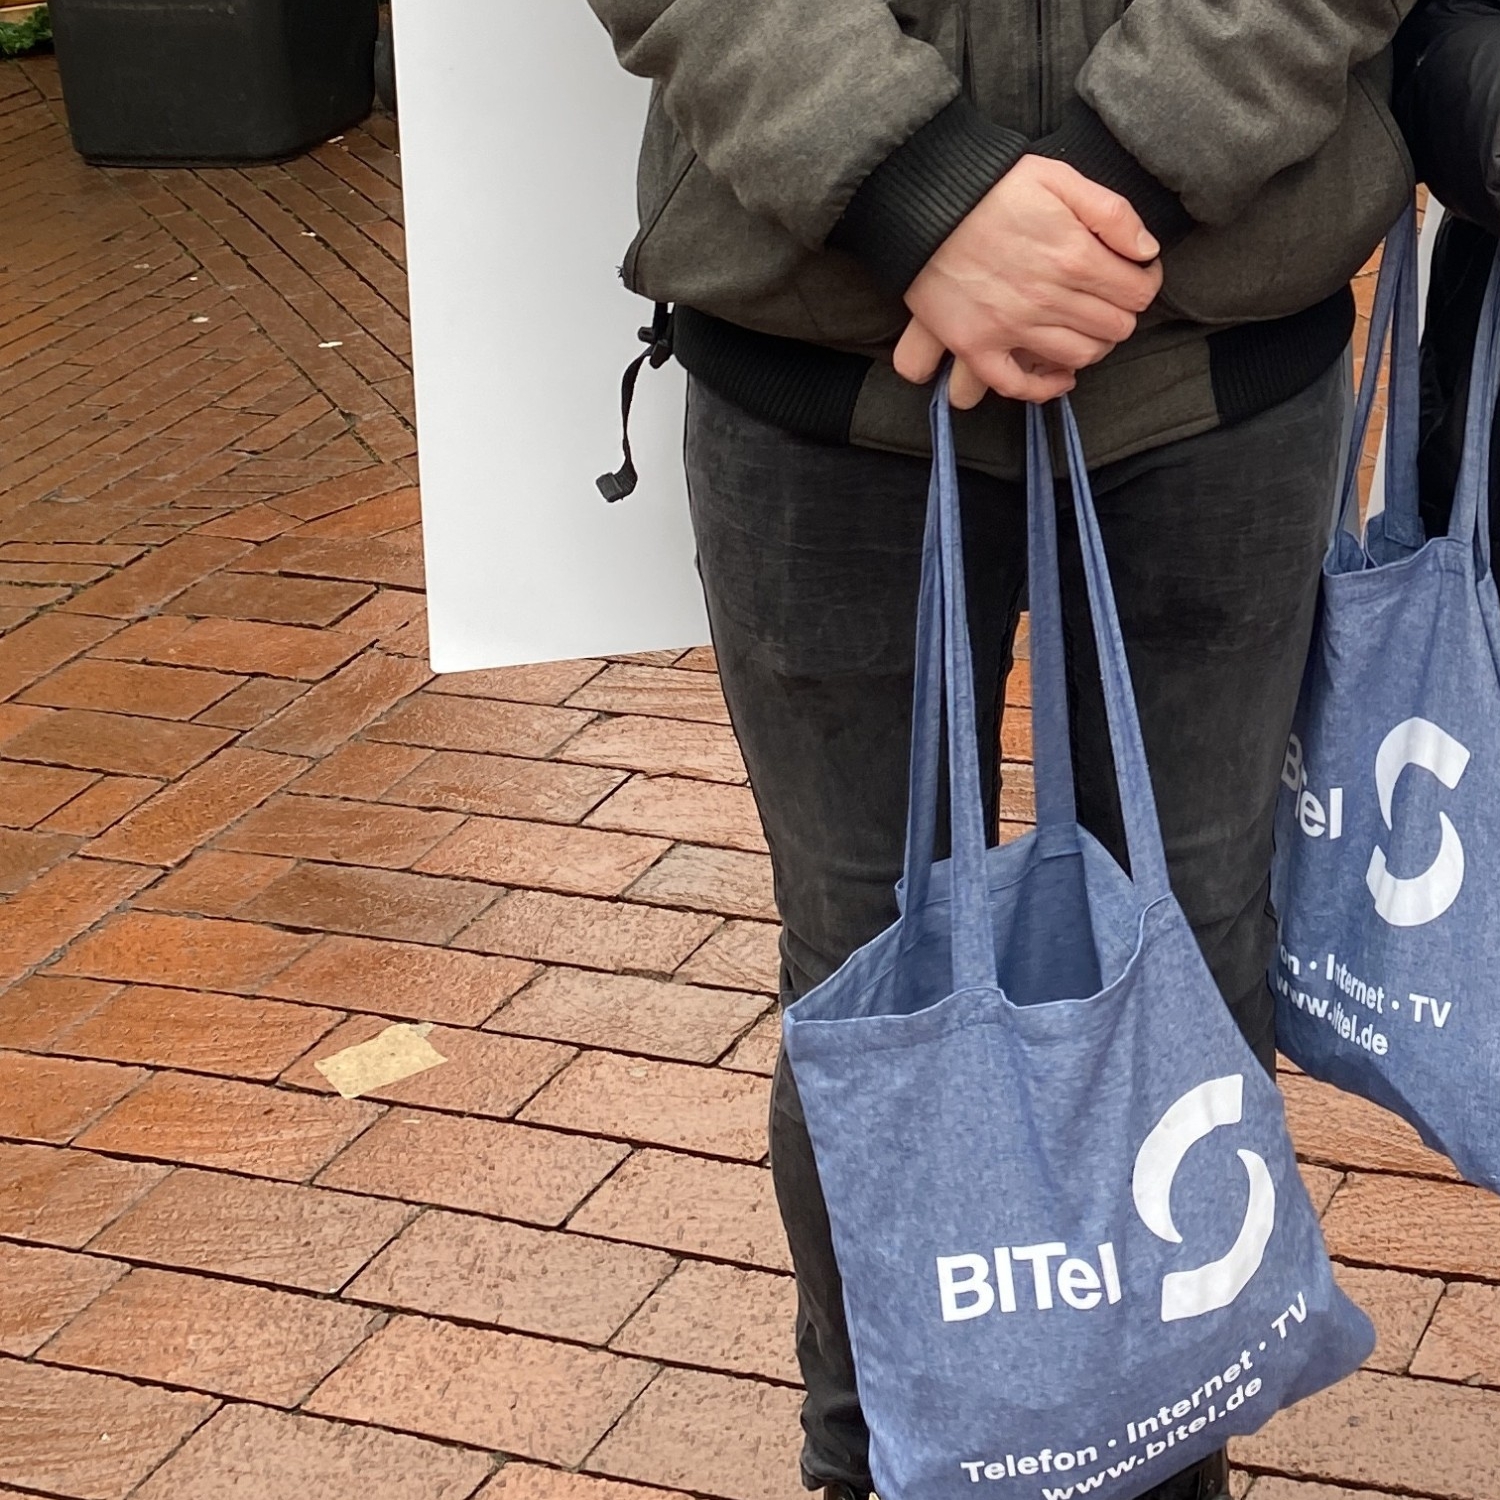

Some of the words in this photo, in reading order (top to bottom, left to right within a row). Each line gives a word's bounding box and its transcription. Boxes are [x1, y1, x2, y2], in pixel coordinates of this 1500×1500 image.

[1326, 954, 1385, 1014] Internet
[1409, 993, 1452, 1028] TV
[936, 1242, 1122, 1322] BITel
[960, 1445, 1098, 1483] Telefon
[1127, 1350, 1253, 1444] Internet
[1271, 1292, 1308, 1339] TV
[1042, 1377, 1262, 1500] www.bitel.de
